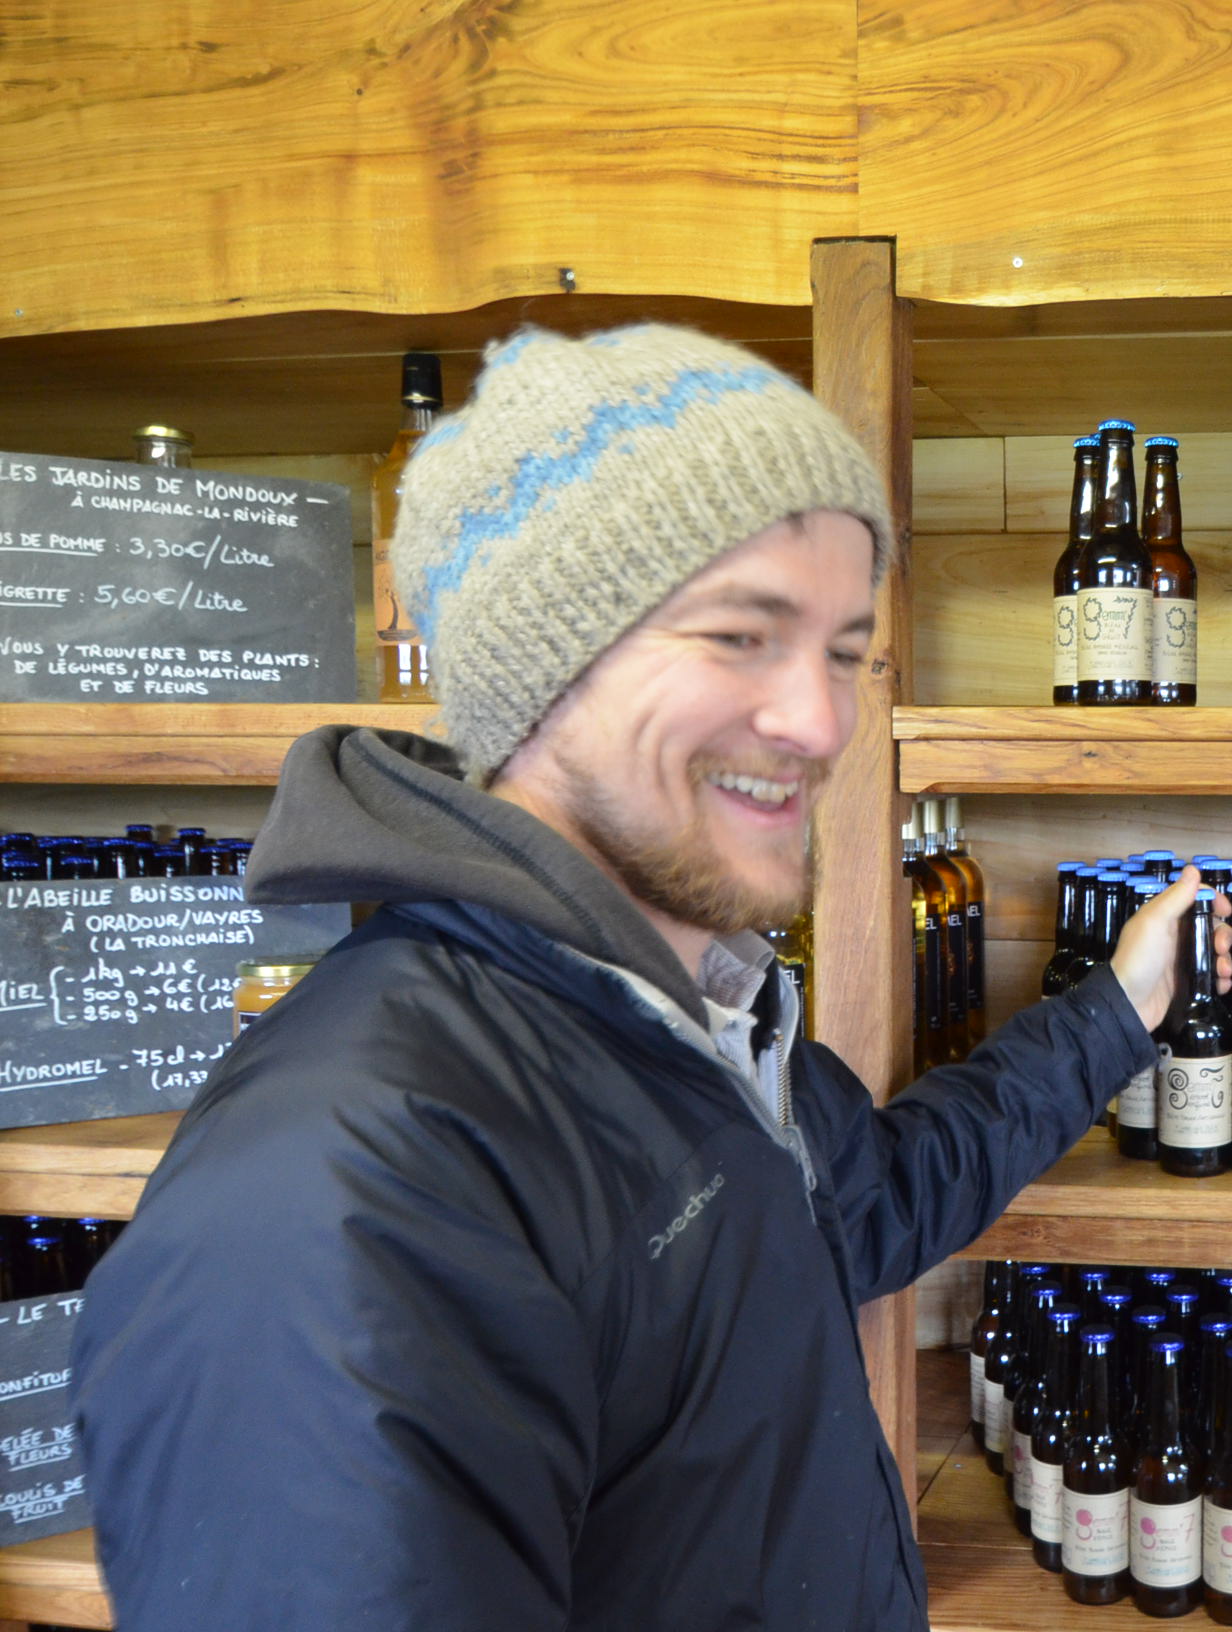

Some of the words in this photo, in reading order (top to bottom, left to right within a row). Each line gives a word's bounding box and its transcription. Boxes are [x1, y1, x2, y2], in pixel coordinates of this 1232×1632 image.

[70, 490, 84, 508] À
[156, 476, 184, 495] DE
[195, 479, 298, 506] MONDOUX
[20, 532, 42, 547] DE
[50, 533, 107, 552] POMME
[56, 643, 70, 657] Y
[74, 644, 187, 661] TROUVEREZ
[198, 649, 233, 663] DES
[13, 659, 38, 674] DE
[80, 679, 104, 692] ET
[113, 680, 136, 693] DE
[144, 680, 209, 696] FLEURS
[61, 911, 75, 934] À
[17, 1303, 47, 1325] LE
[51, 1423, 76, 1441] DE
[8, 1443, 73, 1466] FLEURS
[62, 1473, 87, 1492] DE
